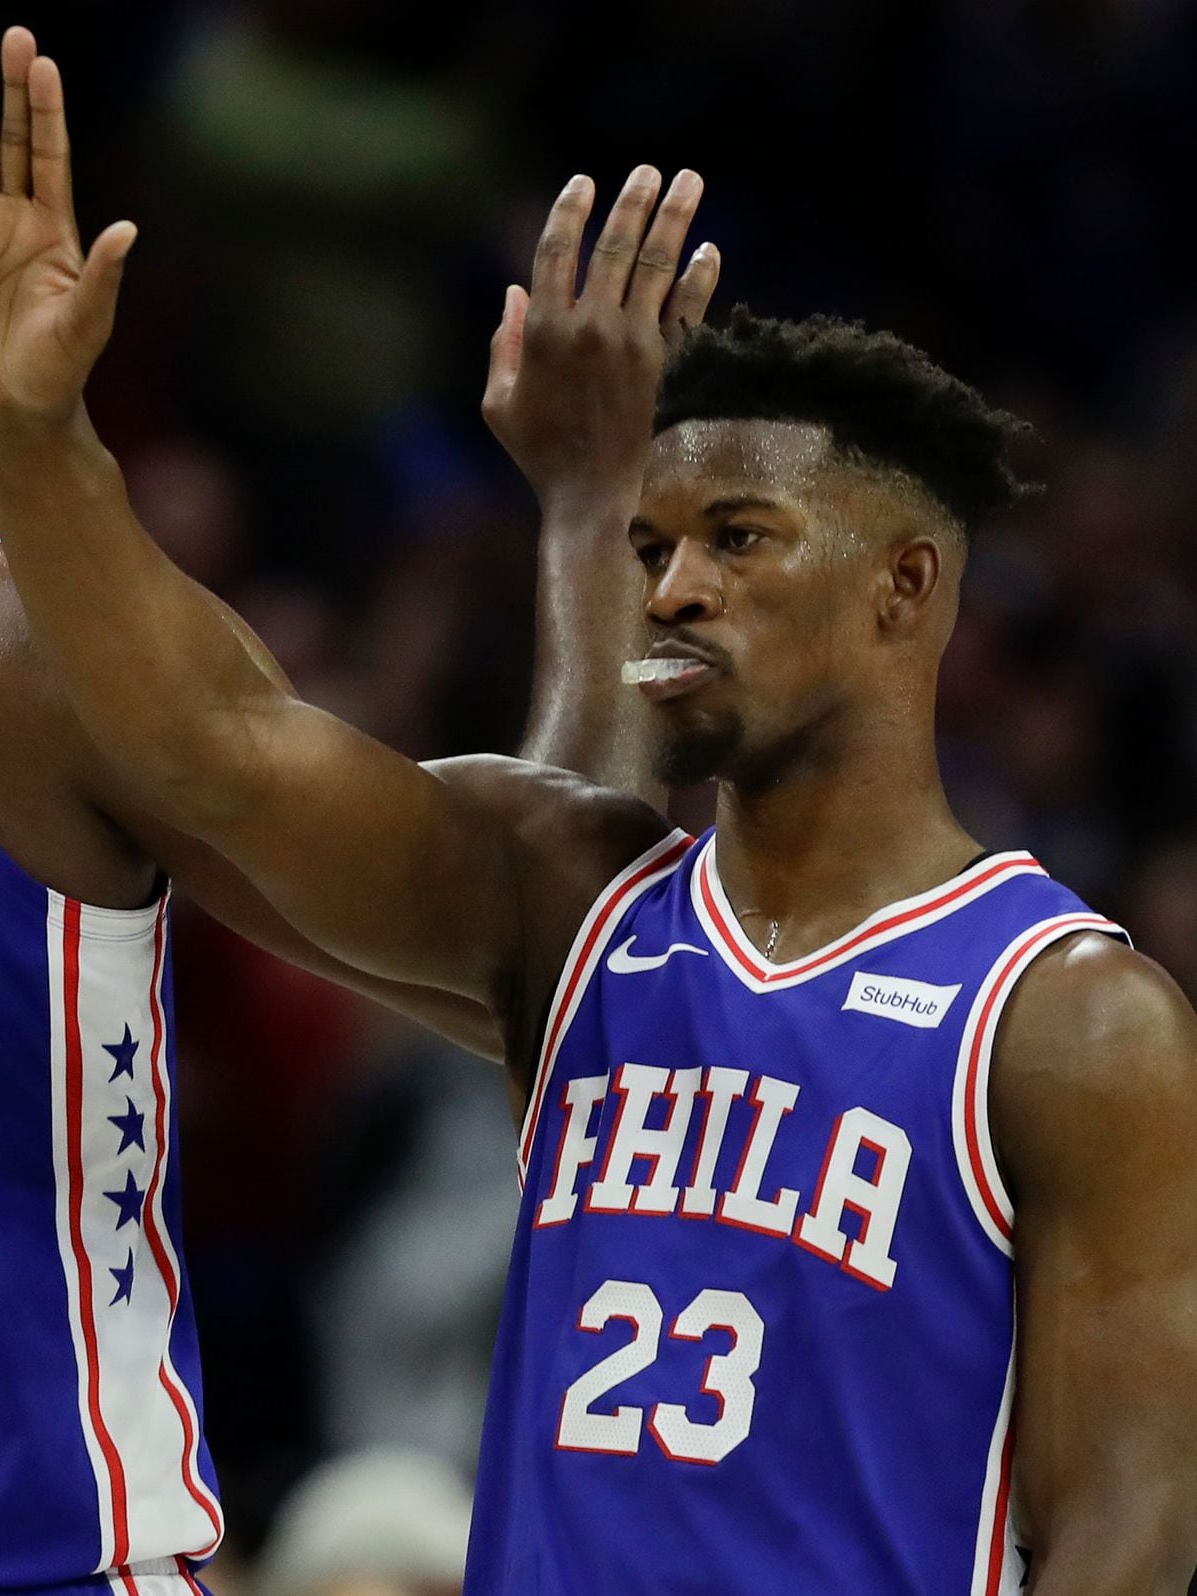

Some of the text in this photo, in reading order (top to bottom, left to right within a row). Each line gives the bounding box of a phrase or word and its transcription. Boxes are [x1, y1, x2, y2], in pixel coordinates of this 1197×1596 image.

[860, 985, 938, 1016] StubHub
[533, 1062, 912, 1292] PHILA
[554, 1279, 765, 1466] 23
